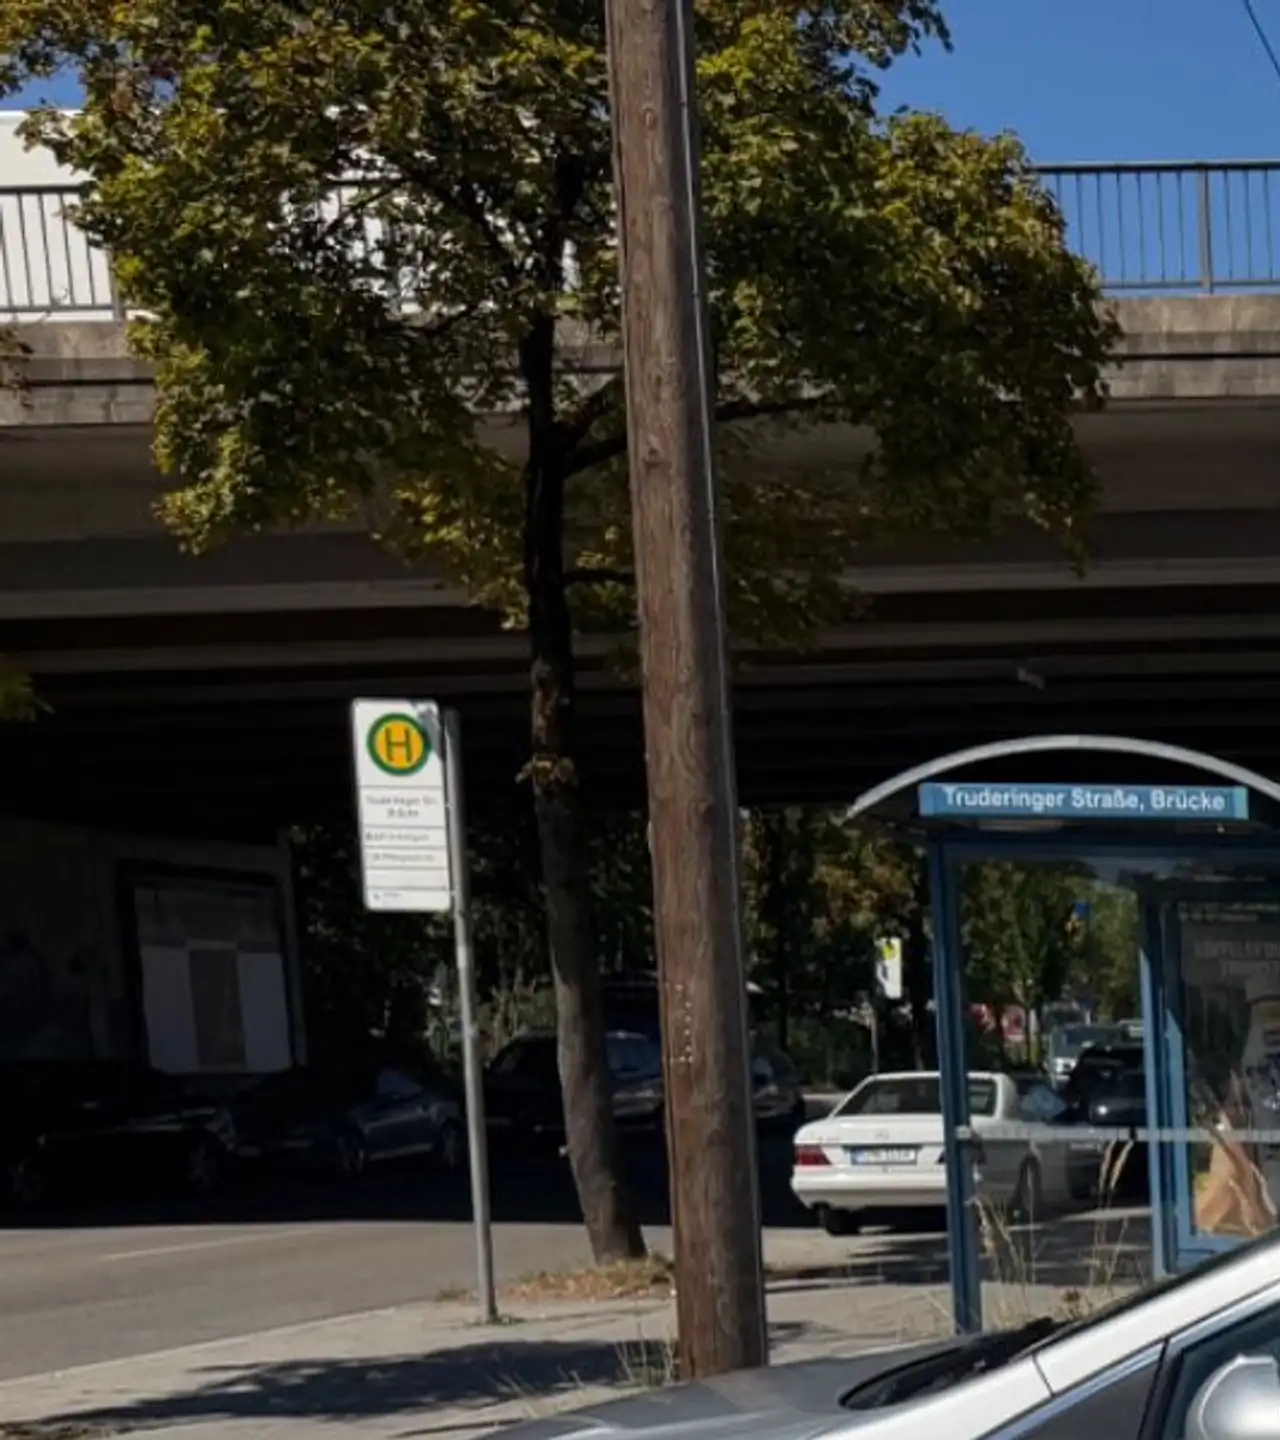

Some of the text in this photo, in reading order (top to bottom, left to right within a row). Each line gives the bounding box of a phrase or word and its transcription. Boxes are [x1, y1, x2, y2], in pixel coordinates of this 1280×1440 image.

[384, 726, 412, 764] H
[943, 786, 1226, 814] Truderinger Straße, Brücke
